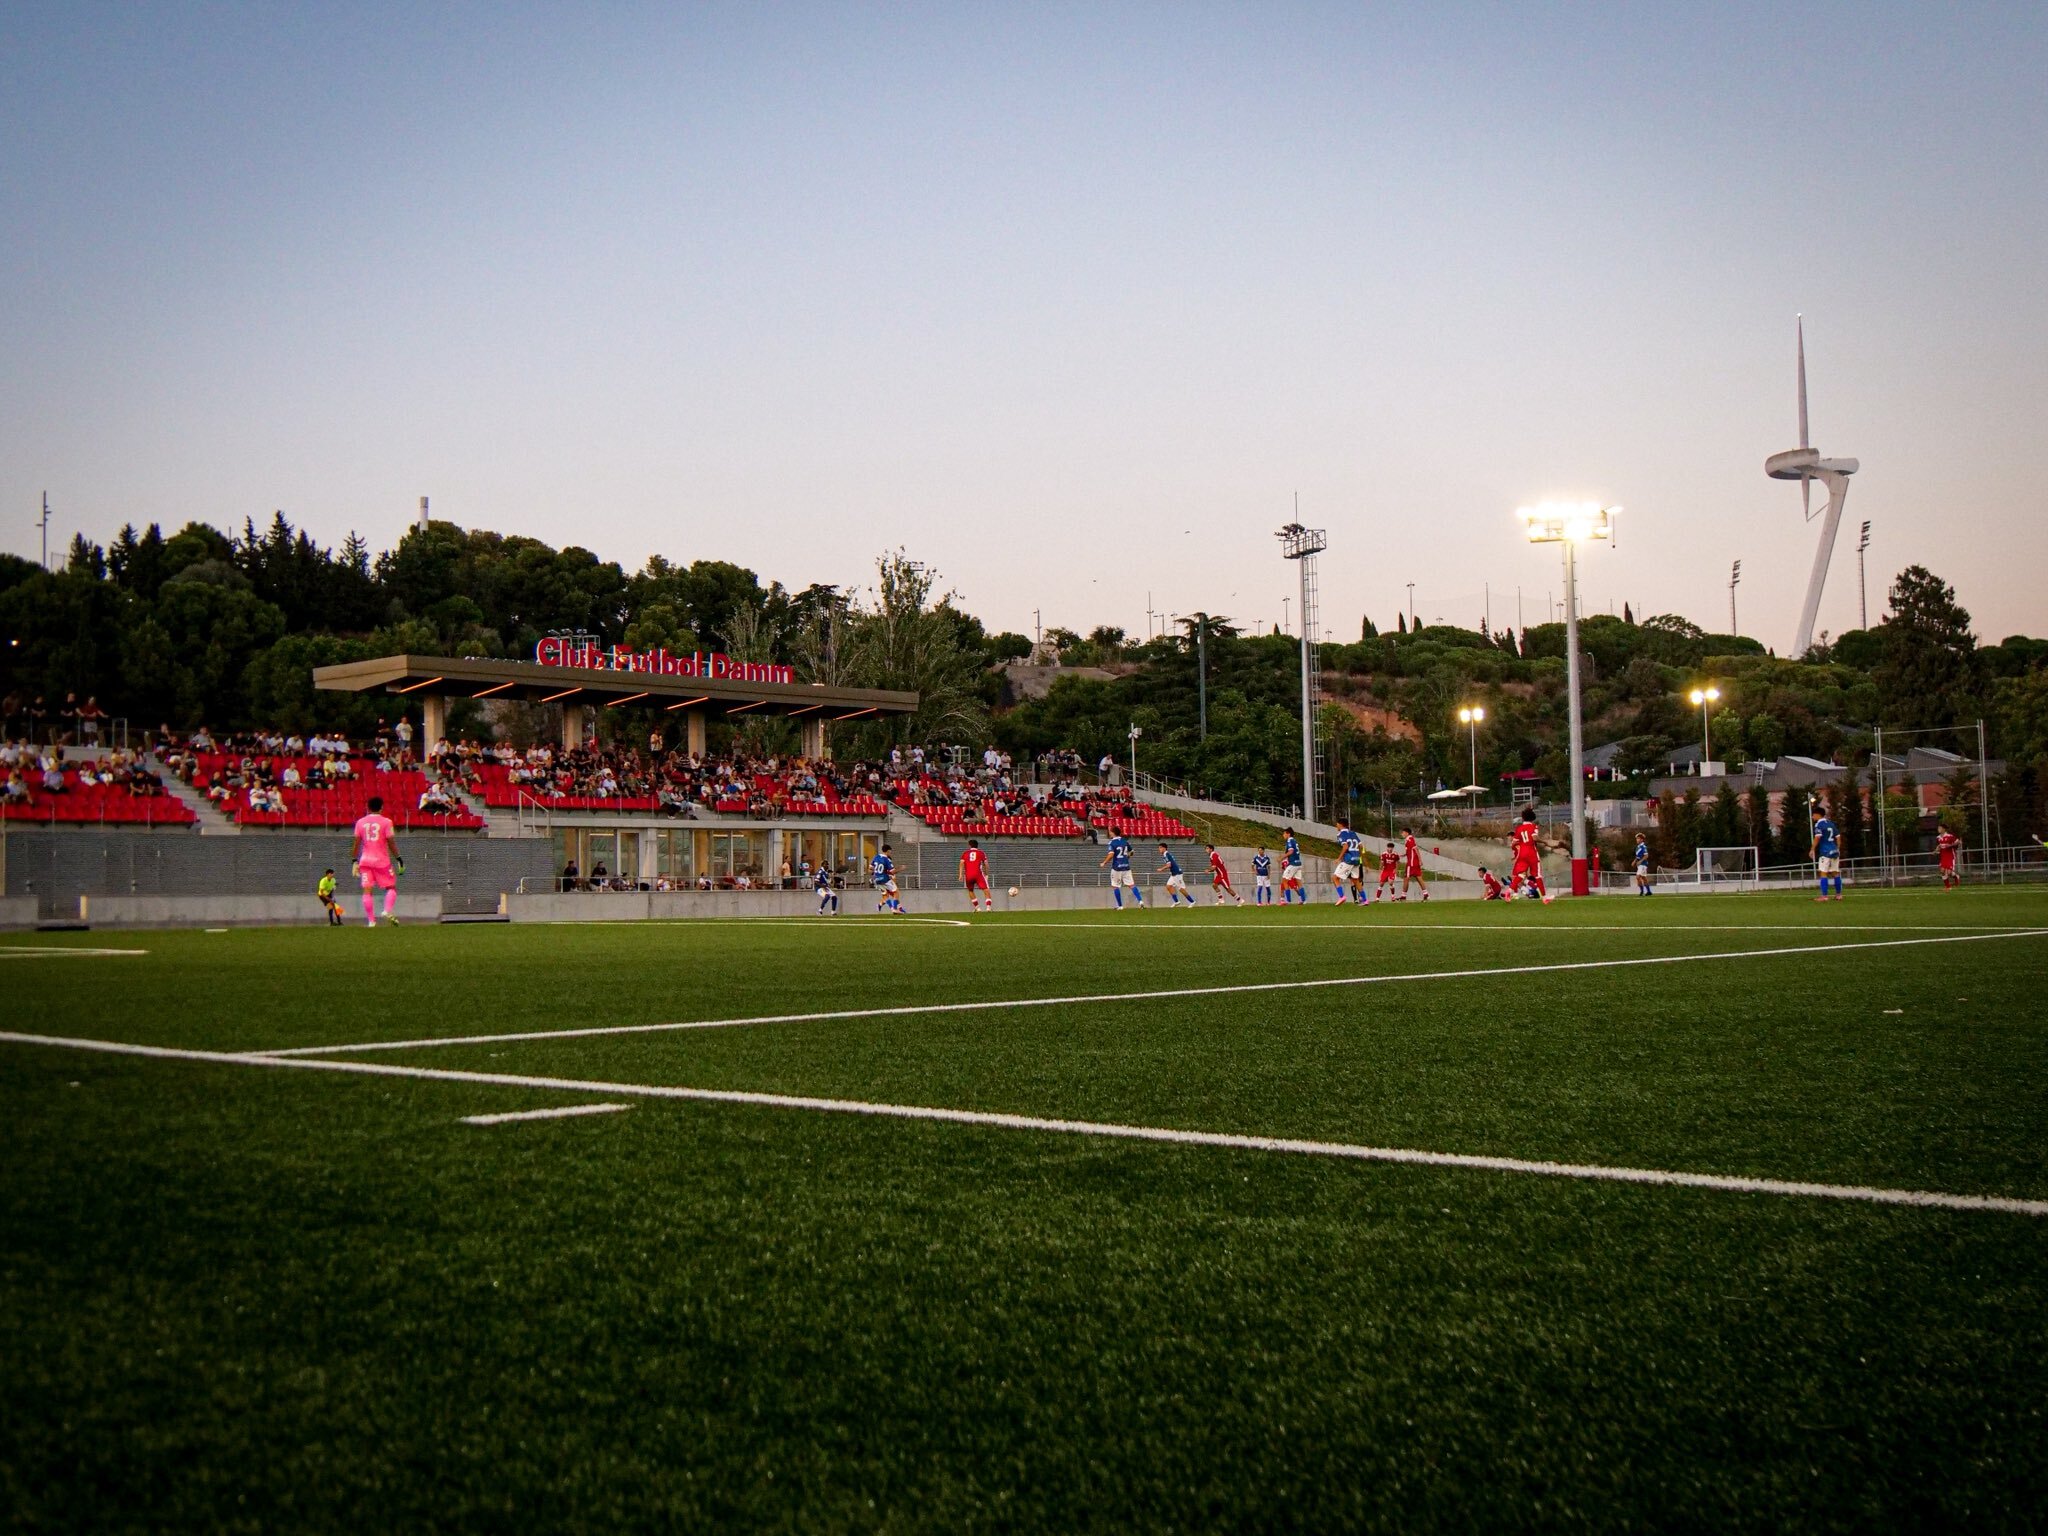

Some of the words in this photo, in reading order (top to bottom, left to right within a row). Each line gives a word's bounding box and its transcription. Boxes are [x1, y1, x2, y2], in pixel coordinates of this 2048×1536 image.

[536, 637, 606, 670] Club
[613, 644, 703, 678] Futbol
[709, 652, 795, 684] Damm
[363, 822, 381, 842] 13
[1520, 830, 1529, 843] 11
[1827, 827, 1834, 841] 2
[1346, 838, 1359, 851] 22
[968, 851, 977, 861] 9
[1116, 846, 1128, 858] 24
[874, 862, 884, 873] 20
